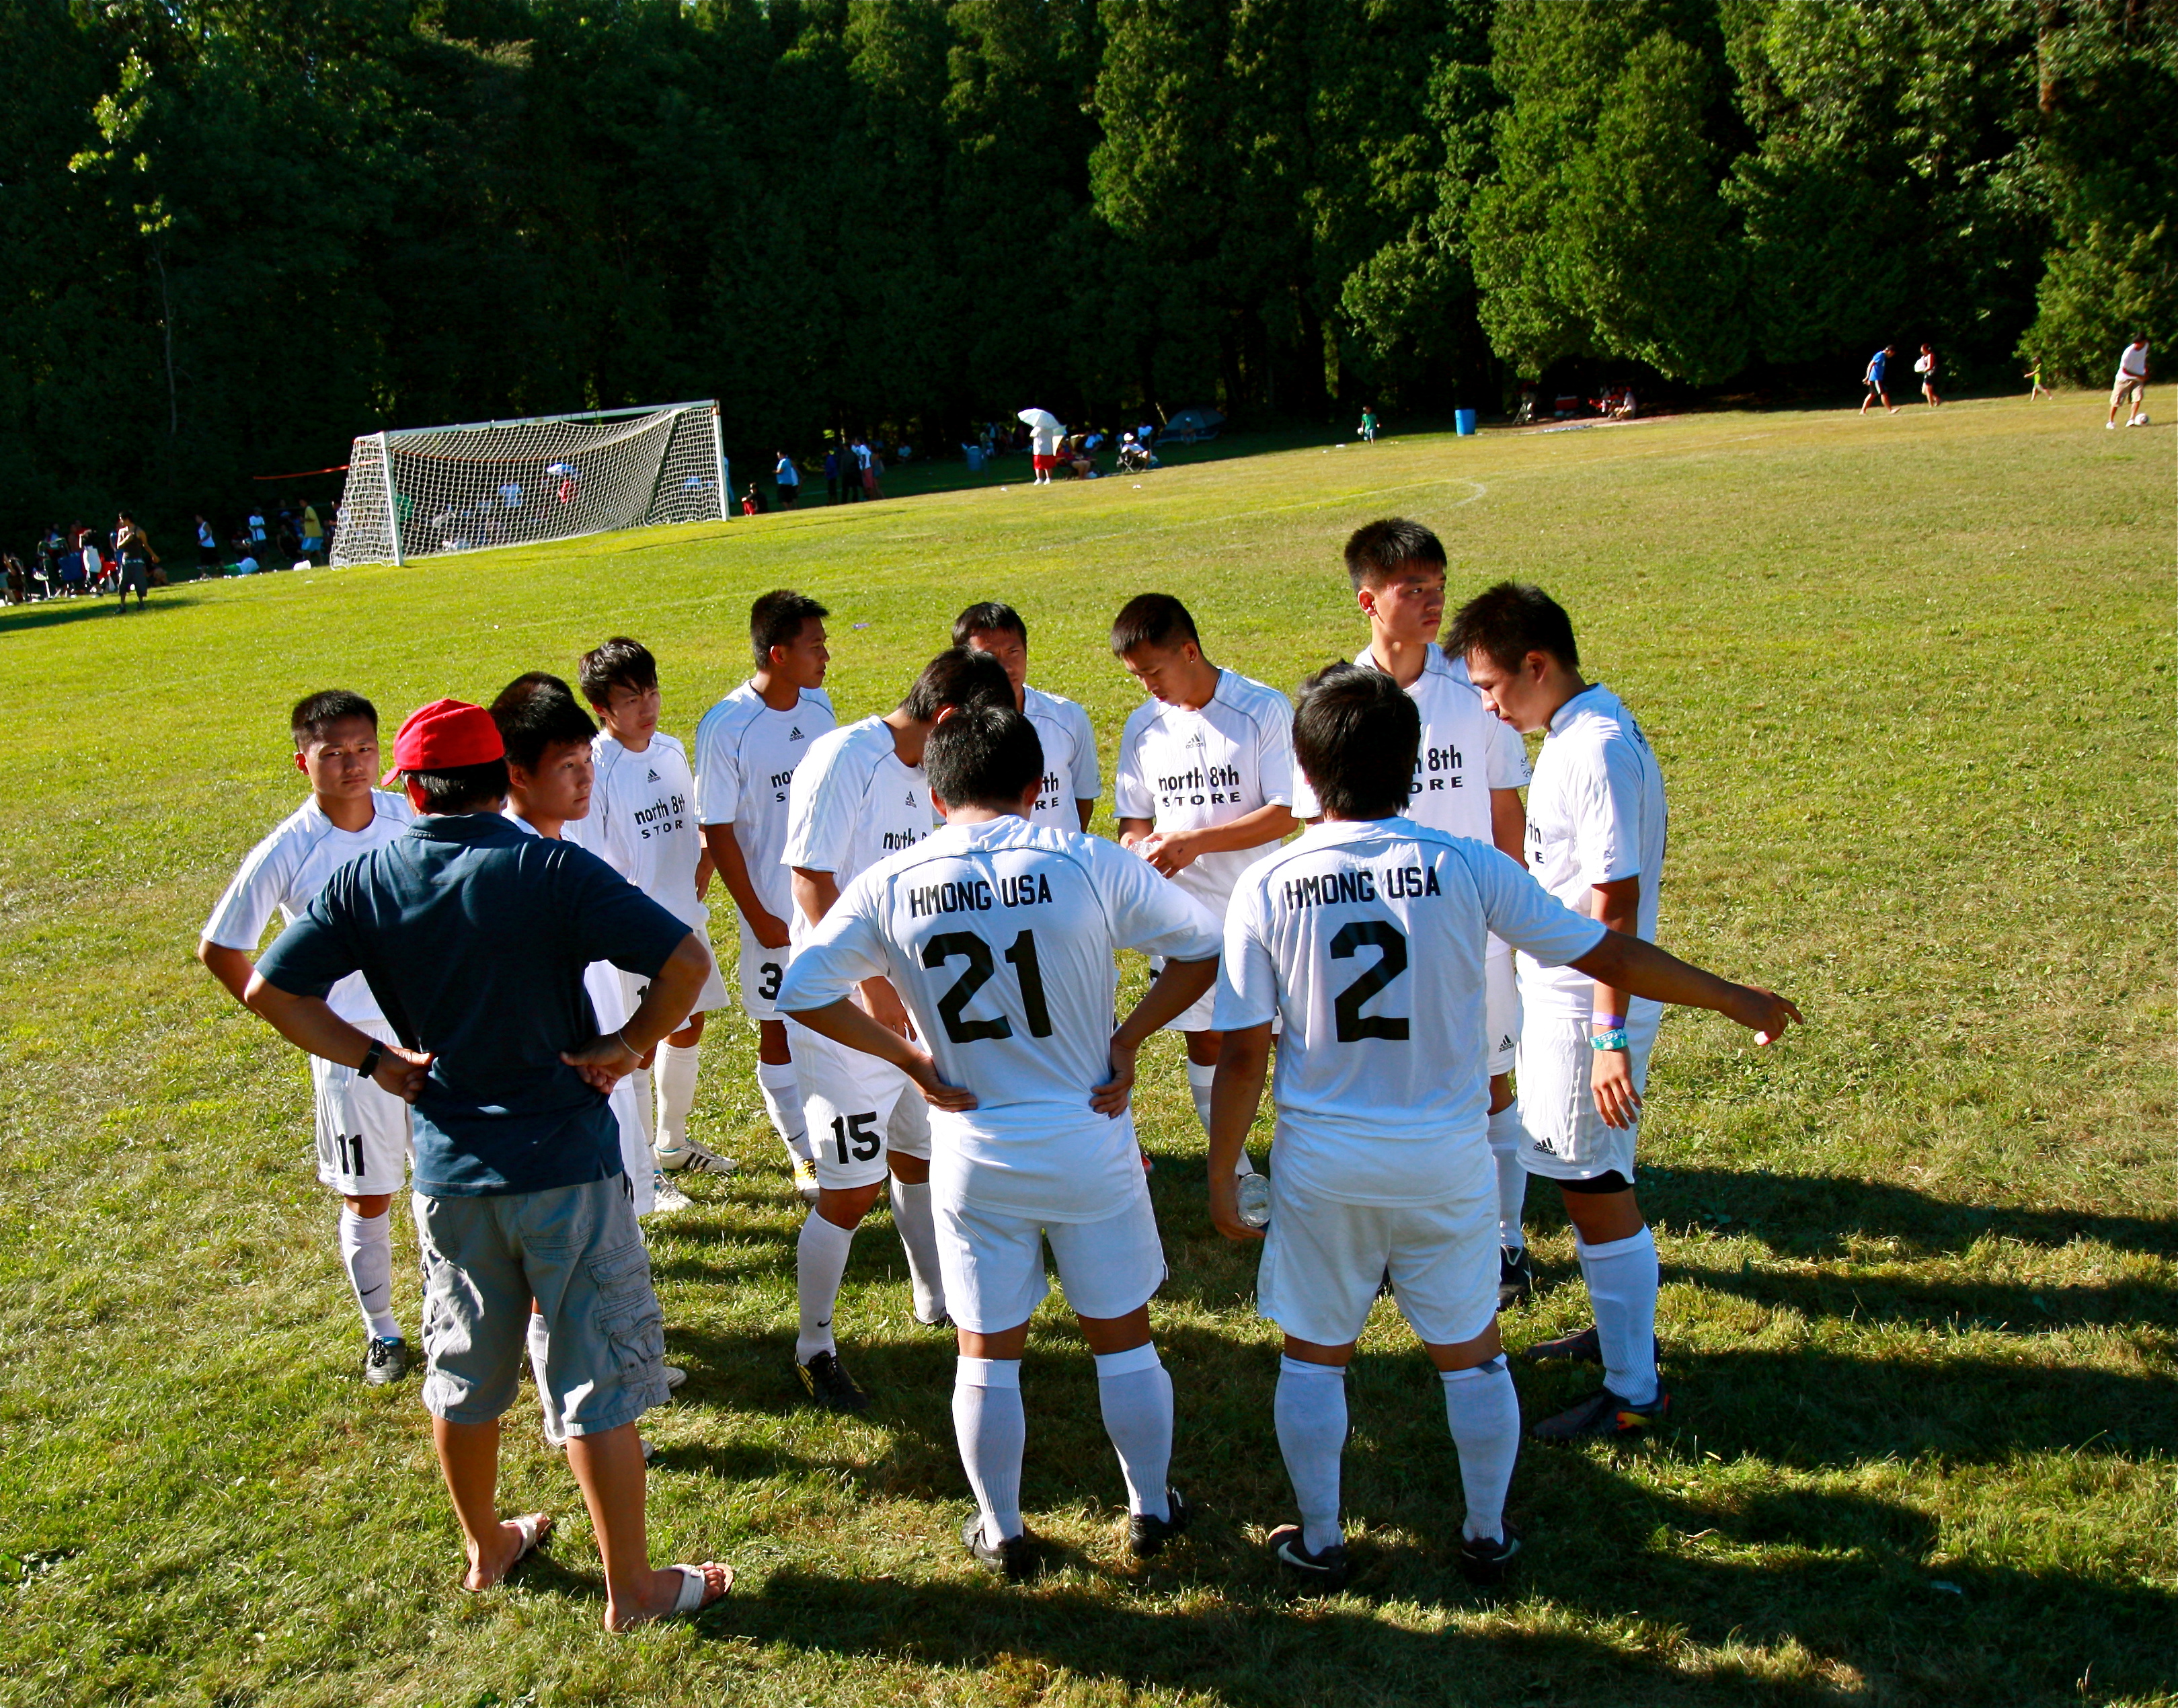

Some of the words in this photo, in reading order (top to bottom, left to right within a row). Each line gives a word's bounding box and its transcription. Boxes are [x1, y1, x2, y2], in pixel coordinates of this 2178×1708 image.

[1428, 744, 1463, 771] 8th
[1041, 772, 1059, 793] th
[1159, 767, 1204, 791] north
[1210, 765, 1239, 787] 8th
[634, 798, 669, 825] north
[671, 793, 685, 814] 8t
[1162, 792, 1241, 807] STORE
[882, 828, 916, 851] noth
[910, 881, 991, 918] HMONG
[1001, 874, 1052, 908] USA
[1285, 871, 1375, 910] HMONG
[1387, 866, 1441, 899] USA
[921, 929, 1053, 1044] 21
[1329, 921, 1409, 1042] 2
[338, 1134, 365, 1176] 11
[830, 1111, 880, 1164] 15
